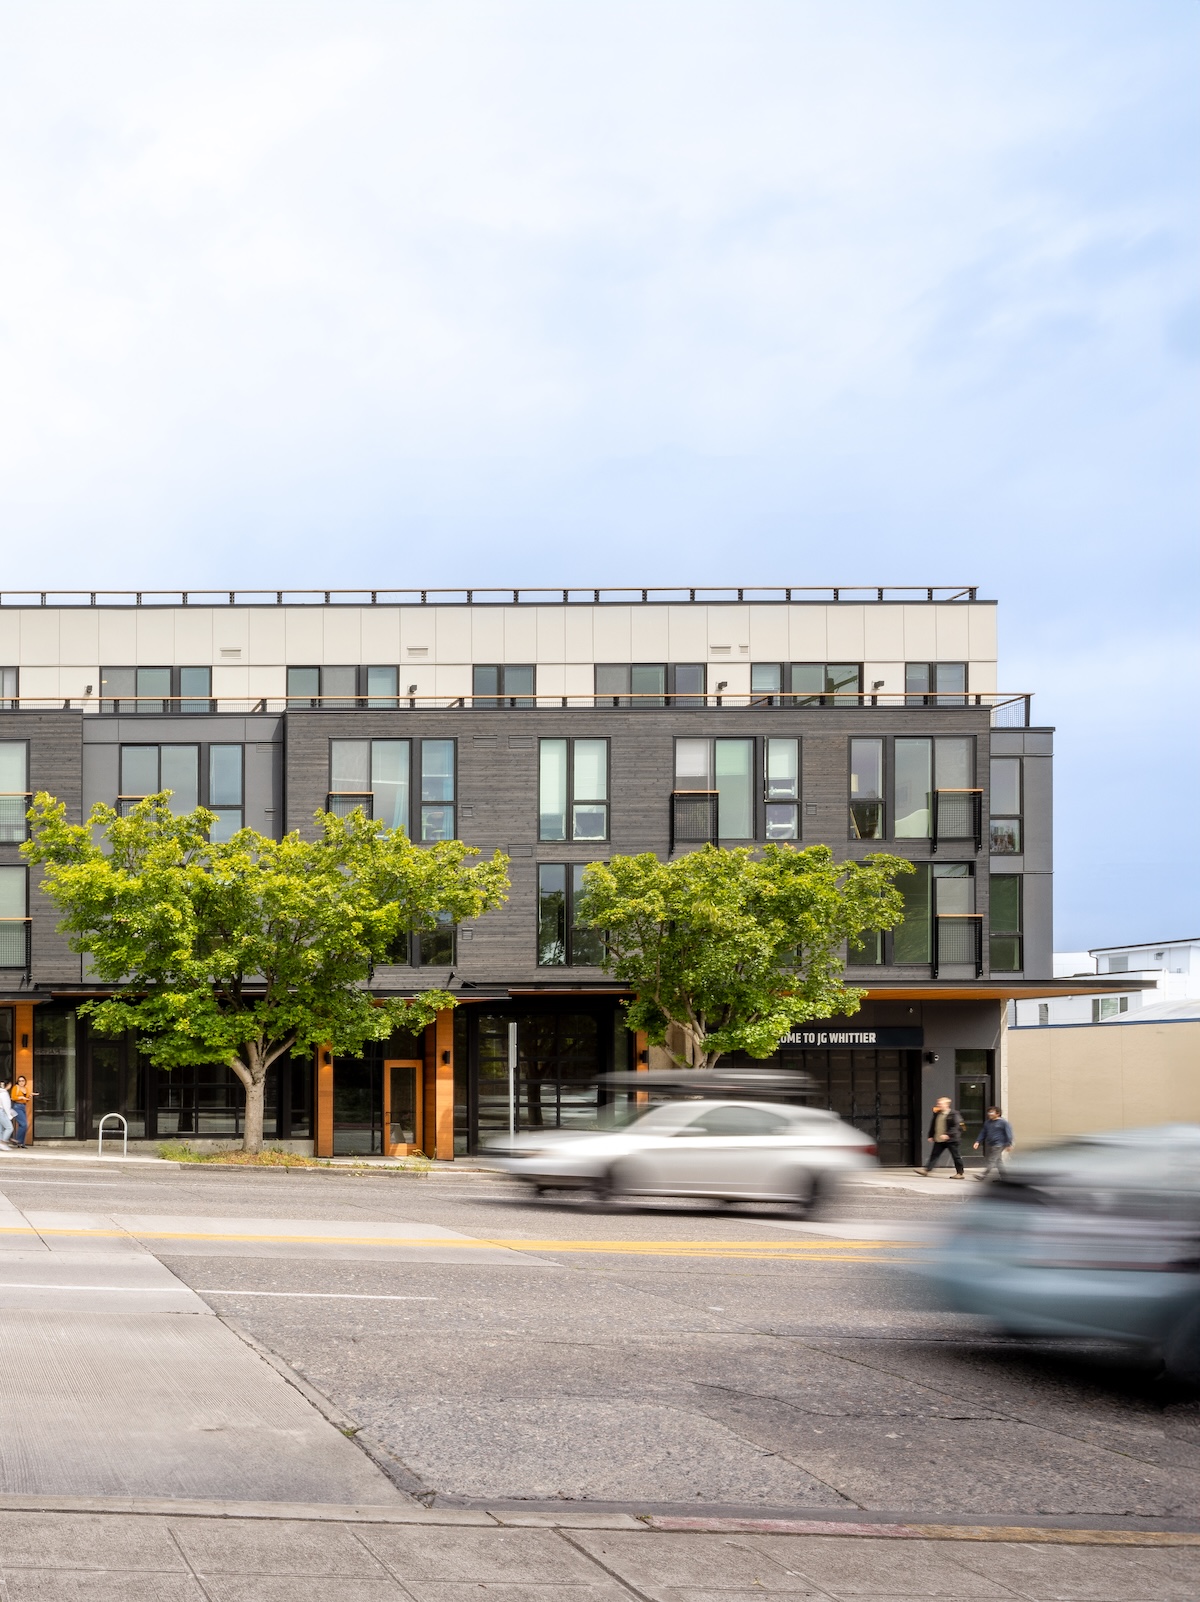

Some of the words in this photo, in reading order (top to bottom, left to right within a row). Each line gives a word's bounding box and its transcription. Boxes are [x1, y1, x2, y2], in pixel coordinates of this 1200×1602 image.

[803, 1032, 815, 1043] TO
[817, 1032, 827, 1046] JG
[829, 1032, 877, 1043] WHITTIER
